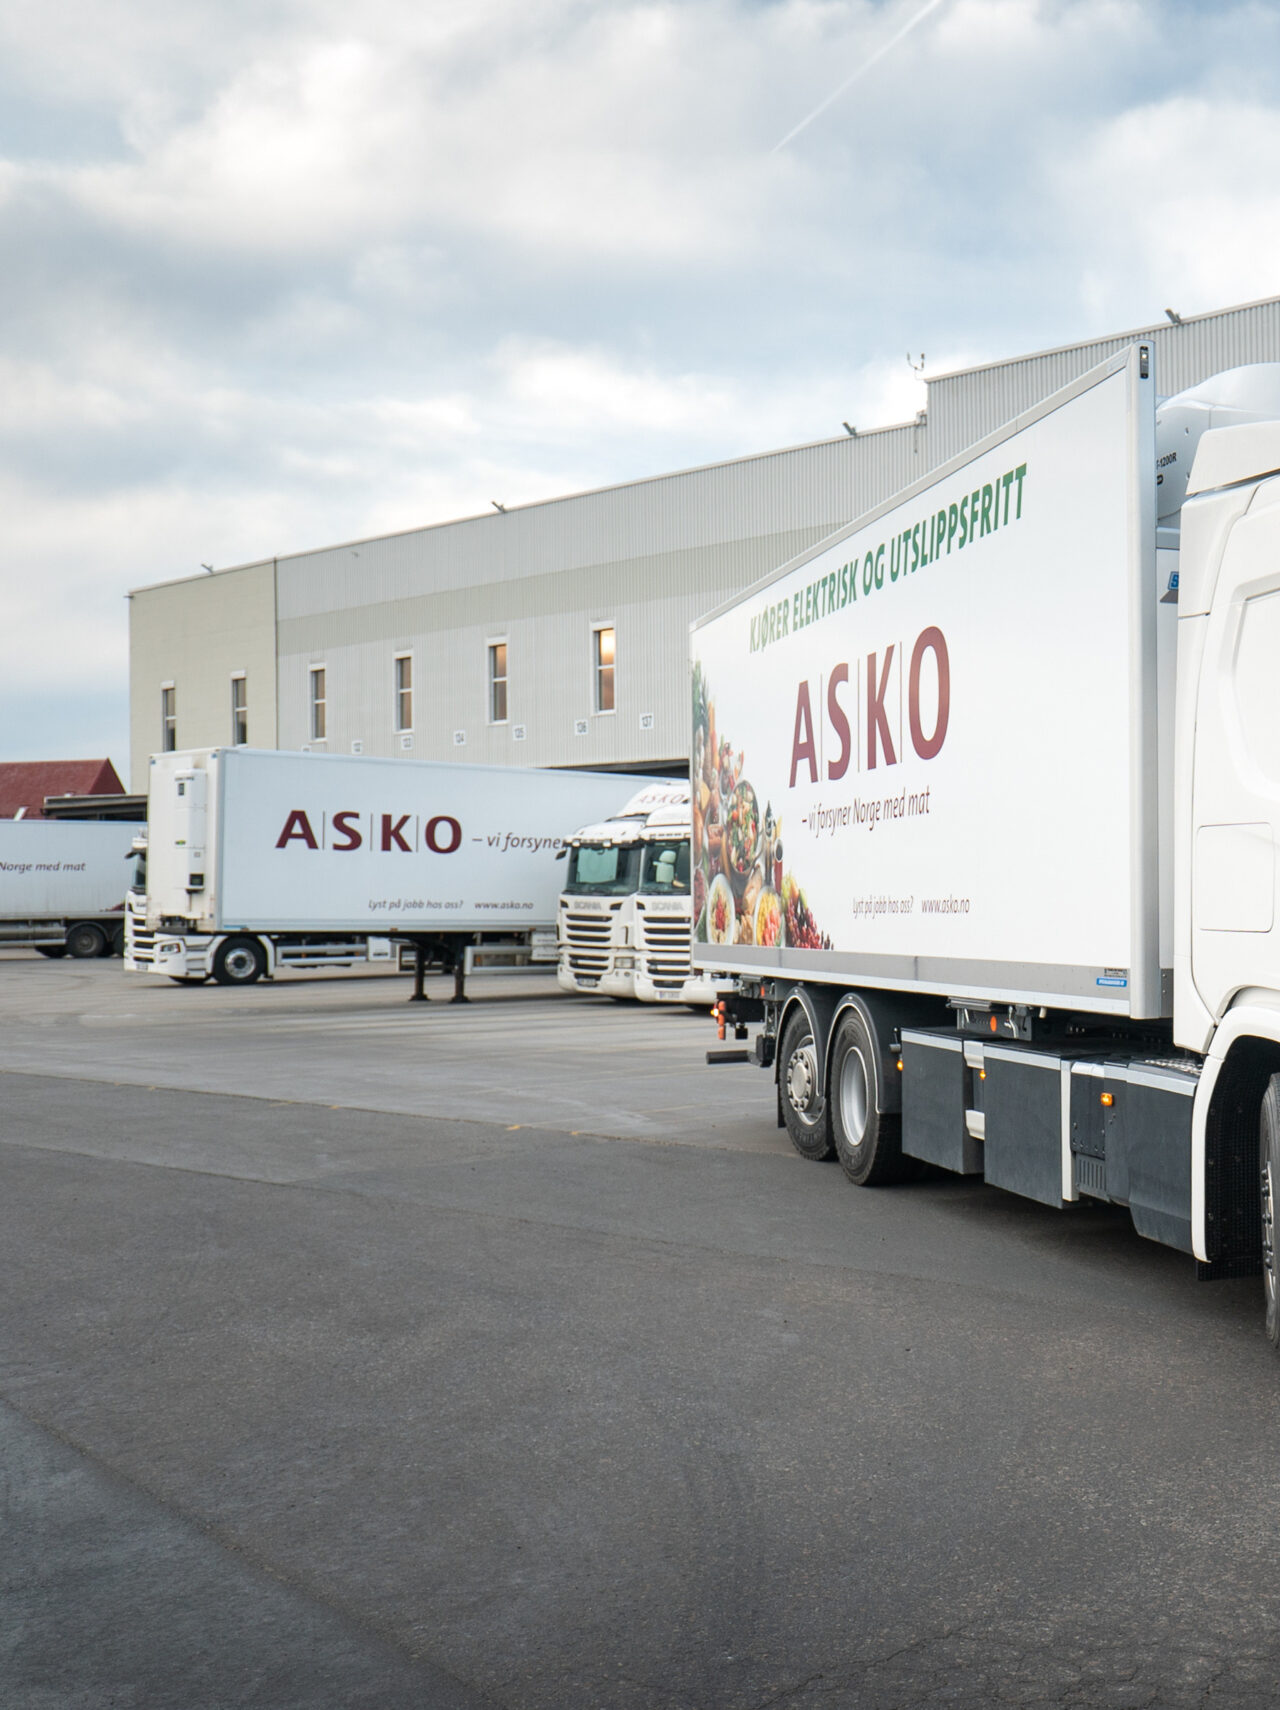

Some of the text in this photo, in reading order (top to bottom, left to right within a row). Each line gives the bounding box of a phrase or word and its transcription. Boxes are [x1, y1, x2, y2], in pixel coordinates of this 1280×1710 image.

[750, 462, 1027, 654] KJØRER ELEKTRISK OG UTSLIPPSFRITT
[789, 625, 950, 788] ASKO
[275, 810, 462, 854] ASKO
[487, 832, 501, 847] vi
[809, 804, 816, 831] vi
[815, 802, 851, 838] forsyner
[853, 797, 881, 831] Norge
[883, 787, 906, 820] med
[908, 785, 930, 816] mat
[35, 861, 61, 872] med
[63, 862, 86, 872] mat
[474, 900, 534, 910] www.asko.no
[922, 893, 970, 913] www.asko.no
